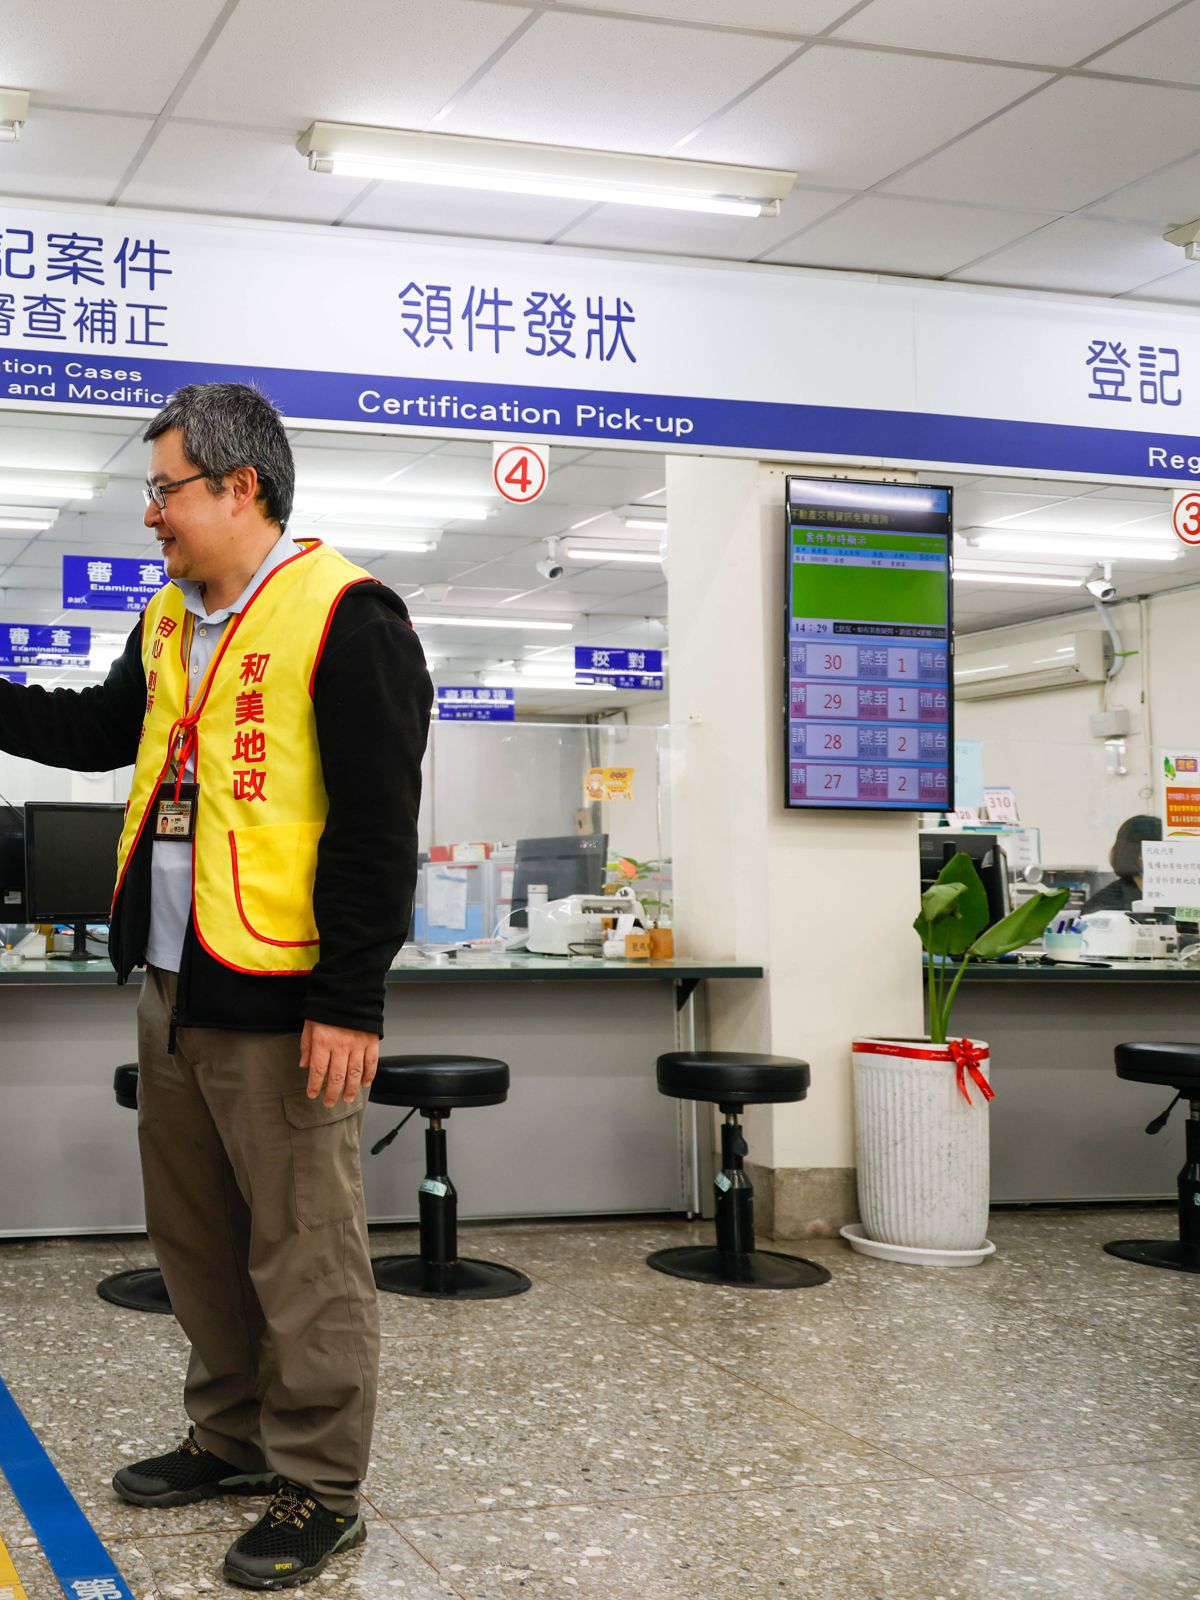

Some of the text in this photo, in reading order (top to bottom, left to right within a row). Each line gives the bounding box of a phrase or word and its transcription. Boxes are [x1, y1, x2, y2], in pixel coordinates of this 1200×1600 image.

[398, 281, 637, 364] 領件發狀
[64, 361, 143, 383] Cases
[1085, 339, 1183, 407] 登記
[8, 378, 56, 398] and
[357, 389, 695, 437] Certification Pick-up
[1148, 446, 1200, 475] Reg
[504, 455, 533, 493] 4
[87, 560, 164, 585] 審查
[89, 583, 161, 594] Examination
[8, 626, 72, 647] 審查
[10, 645, 70, 655] Examination
[823, 654, 843, 670] 30
[858, 649, 888, 666] 號至
[897, 657, 907, 673] 1
[823, 693, 843, 709] 29
[858, 689, 888, 706] 號至
[897, 696, 907, 712] 1
[231, 652, 271, 804] 和美地政
[823, 733, 843, 749] 28
[858, 729, 888, 746] 號至
[897, 736, 907, 752] 2
[823, 773, 843, 789] 27
[858, 768, 888, 785] 號至
[897, 775, 907, 791] 2
[274, 1562, 293, 1571] SPORT
